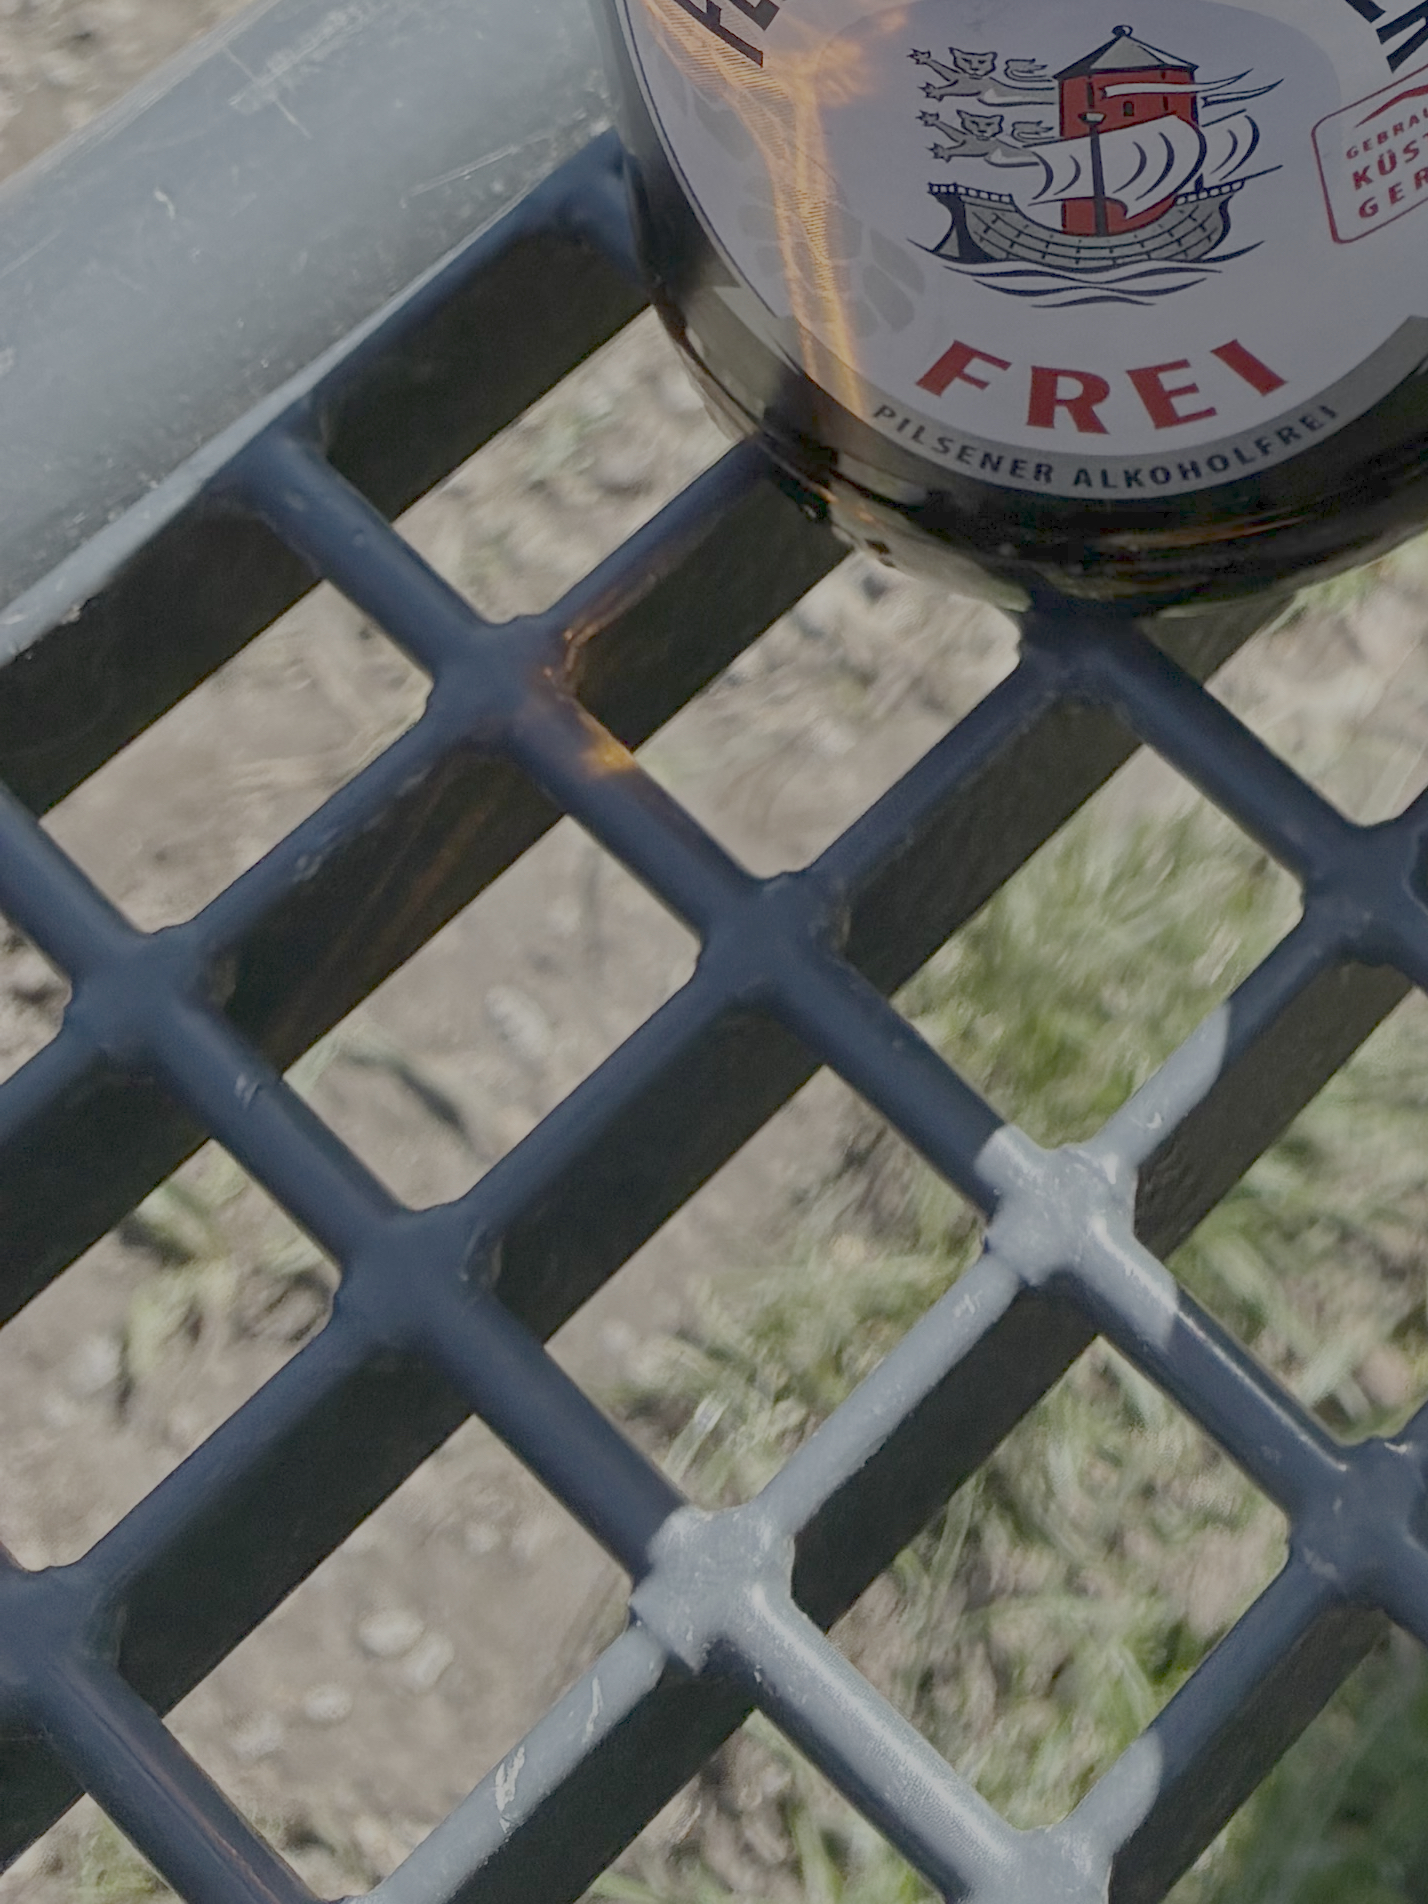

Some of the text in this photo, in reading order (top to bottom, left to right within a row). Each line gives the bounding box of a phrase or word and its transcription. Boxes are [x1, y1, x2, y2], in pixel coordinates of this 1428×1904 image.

[915, 338, 1289, 436] FREI
[871, 403, 1340, 490] PILSENER ALKOHOLFREI
